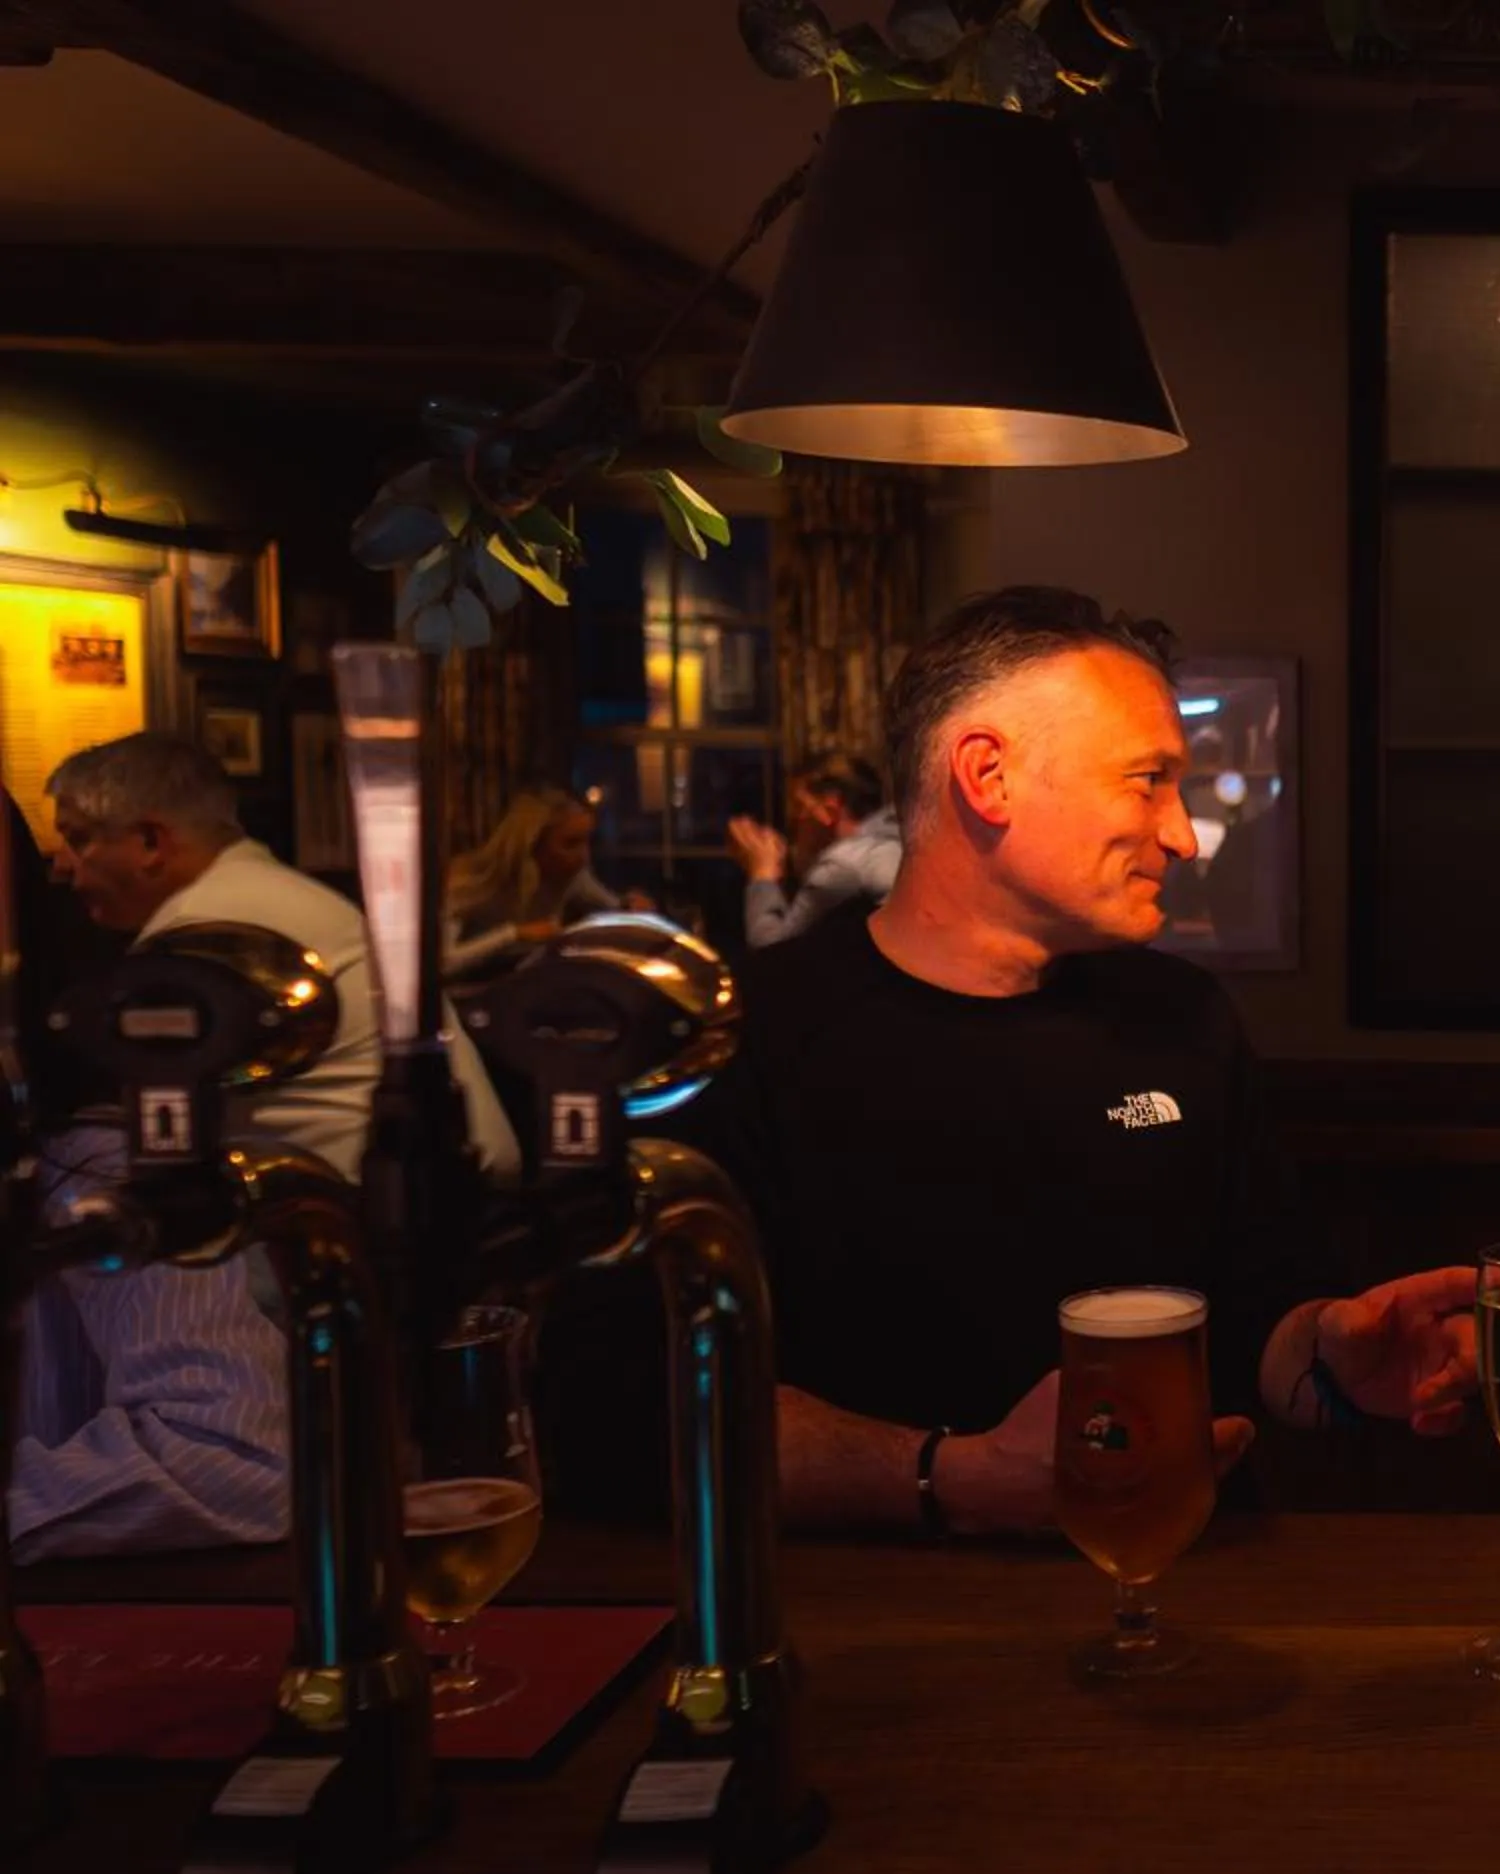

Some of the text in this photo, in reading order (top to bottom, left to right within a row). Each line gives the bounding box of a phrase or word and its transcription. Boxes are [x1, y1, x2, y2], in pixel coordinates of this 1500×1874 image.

[1123, 1094, 1149, 1107] THE
[1107, 1101, 1154, 1121] NORTH
[1124, 1115, 1158, 1129] FACE
